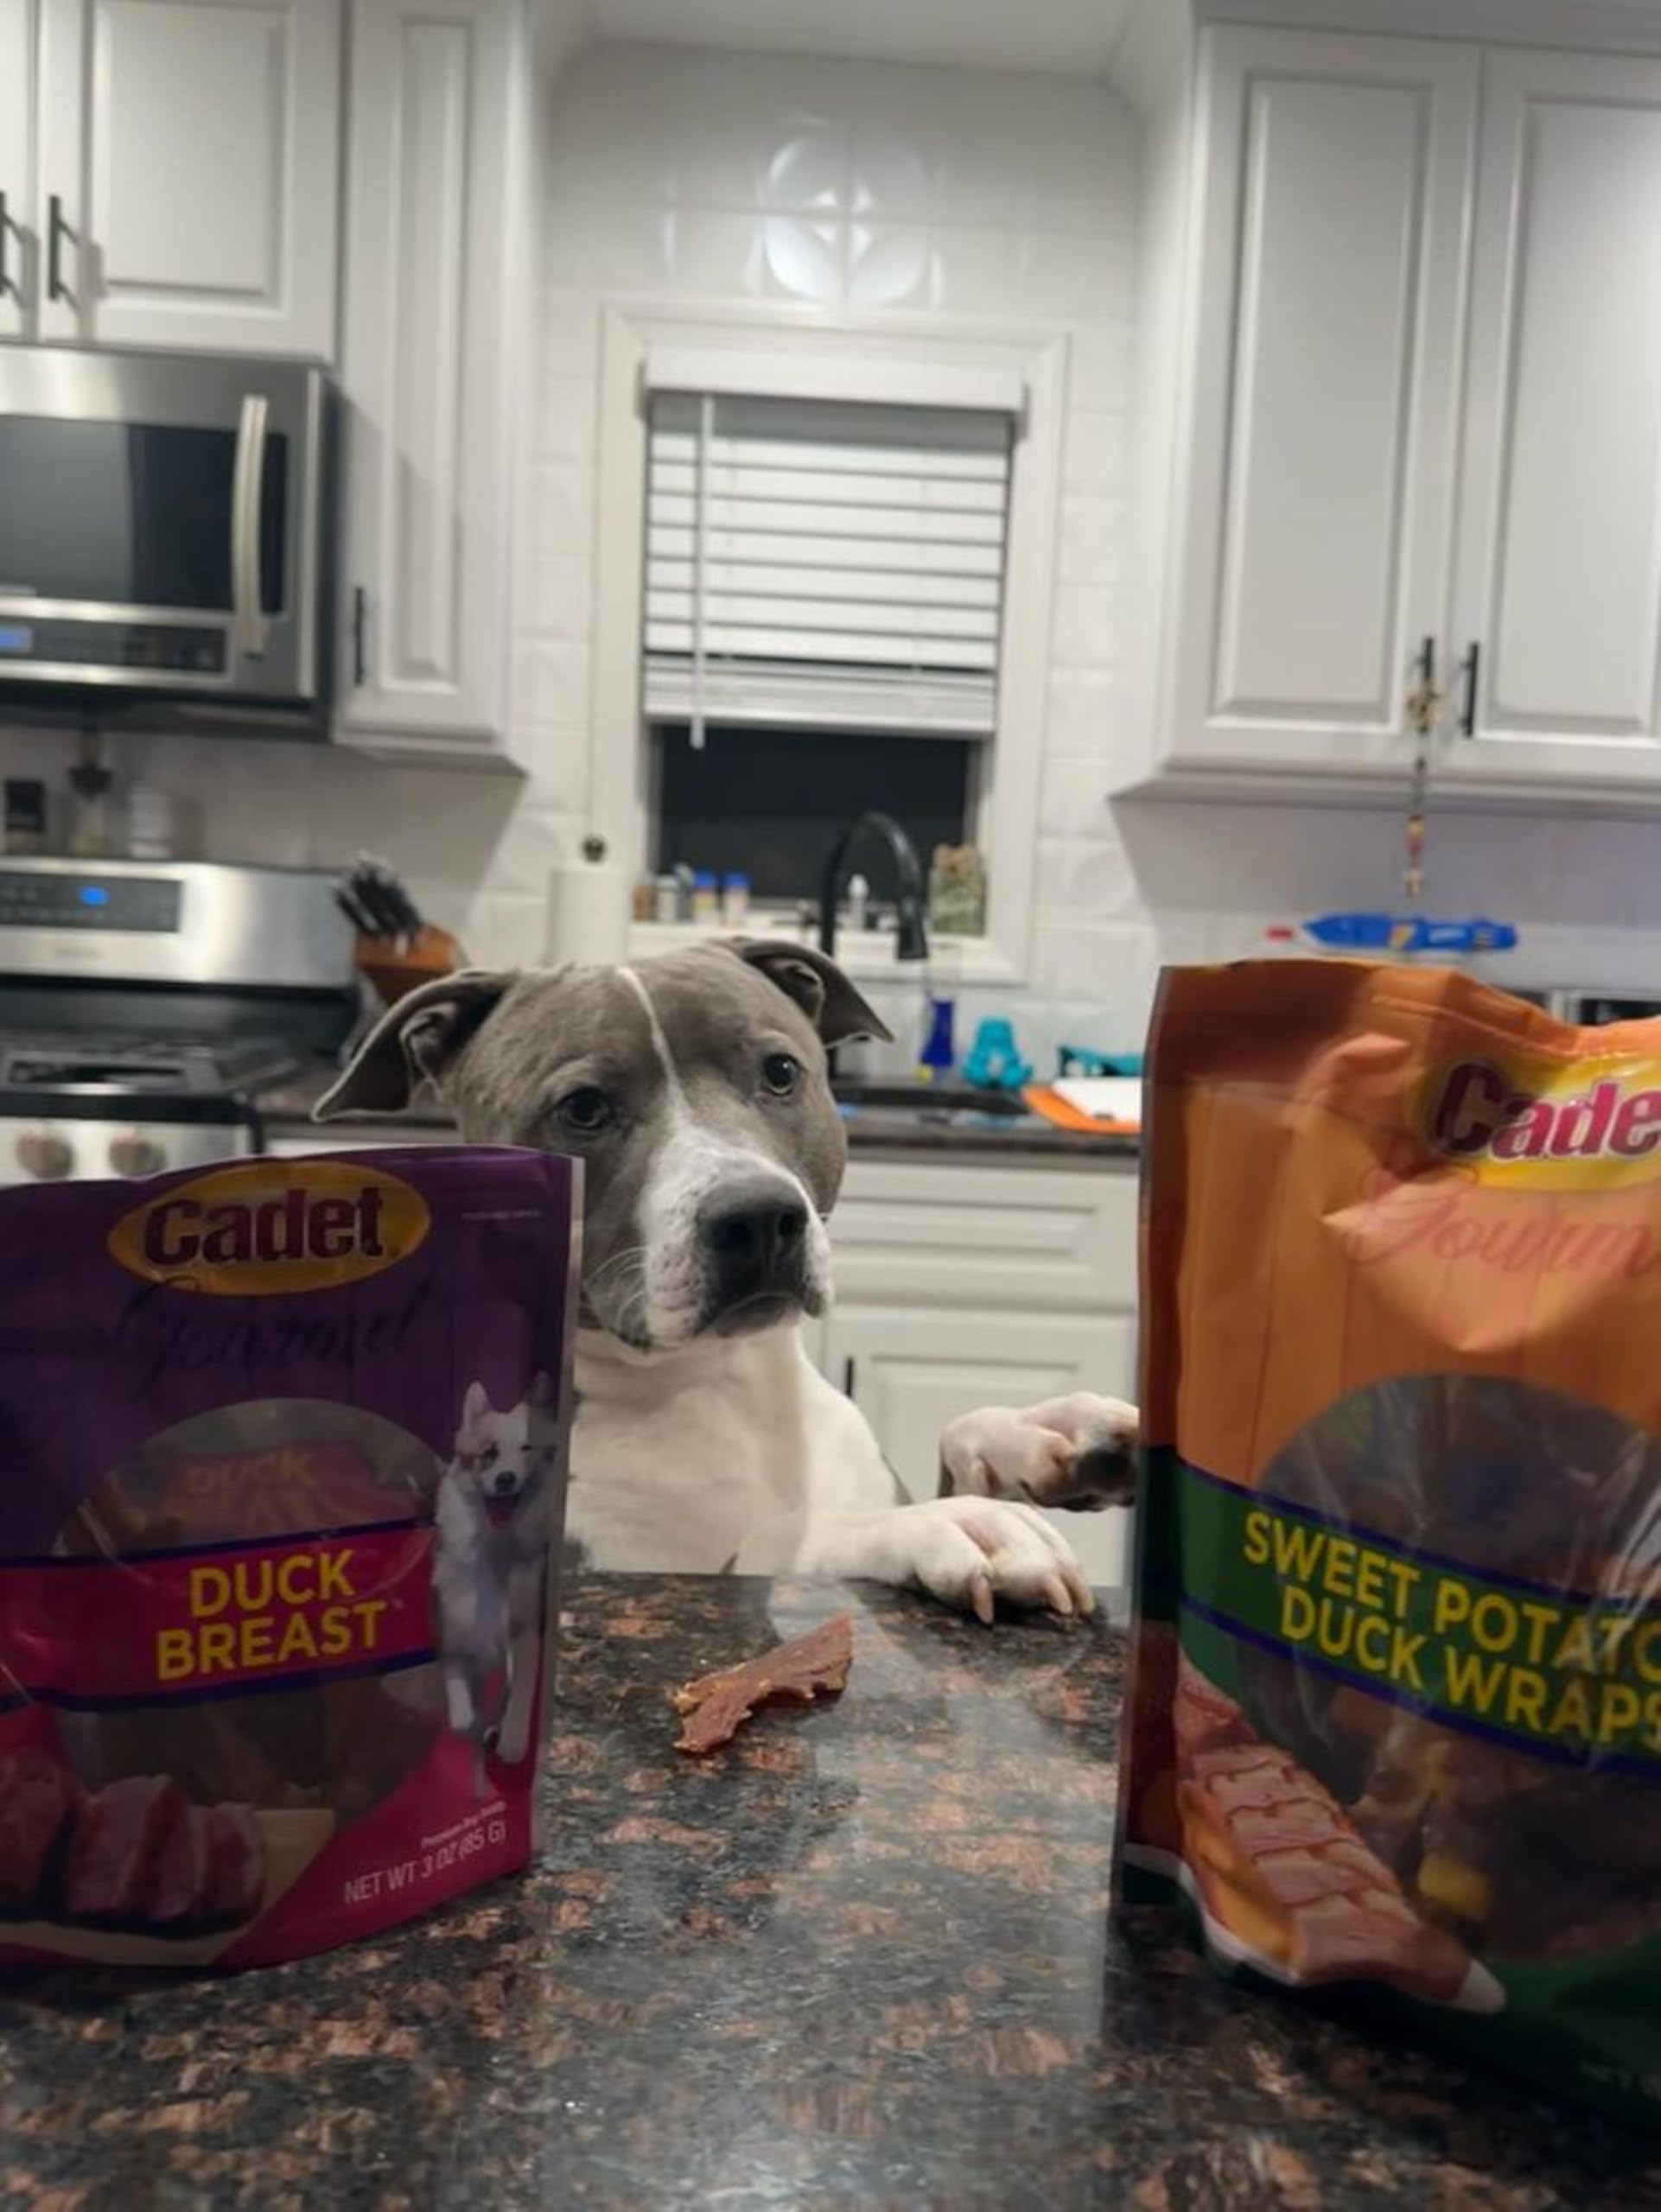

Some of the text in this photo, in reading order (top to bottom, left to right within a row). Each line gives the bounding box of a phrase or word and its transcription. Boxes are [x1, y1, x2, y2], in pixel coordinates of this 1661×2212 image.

[143, 1185, 385, 1266] Cadet
[189, 1548, 356, 1618] DUCK
[1242, 1510, 1421, 1619] SWEET
[155, 1600, 386, 1681] BREAST
[1280, 1585, 1661, 1757] DUCK WRAPS
[344, 1871, 384, 1904] NET
[387, 1860, 418, 1891] WT
[421, 1855, 432, 1878] 3
[436, 1840, 459, 1870] OZ
[459, 1827, 484, 1861] (85
[487, 1819, 506, 1846] G)
